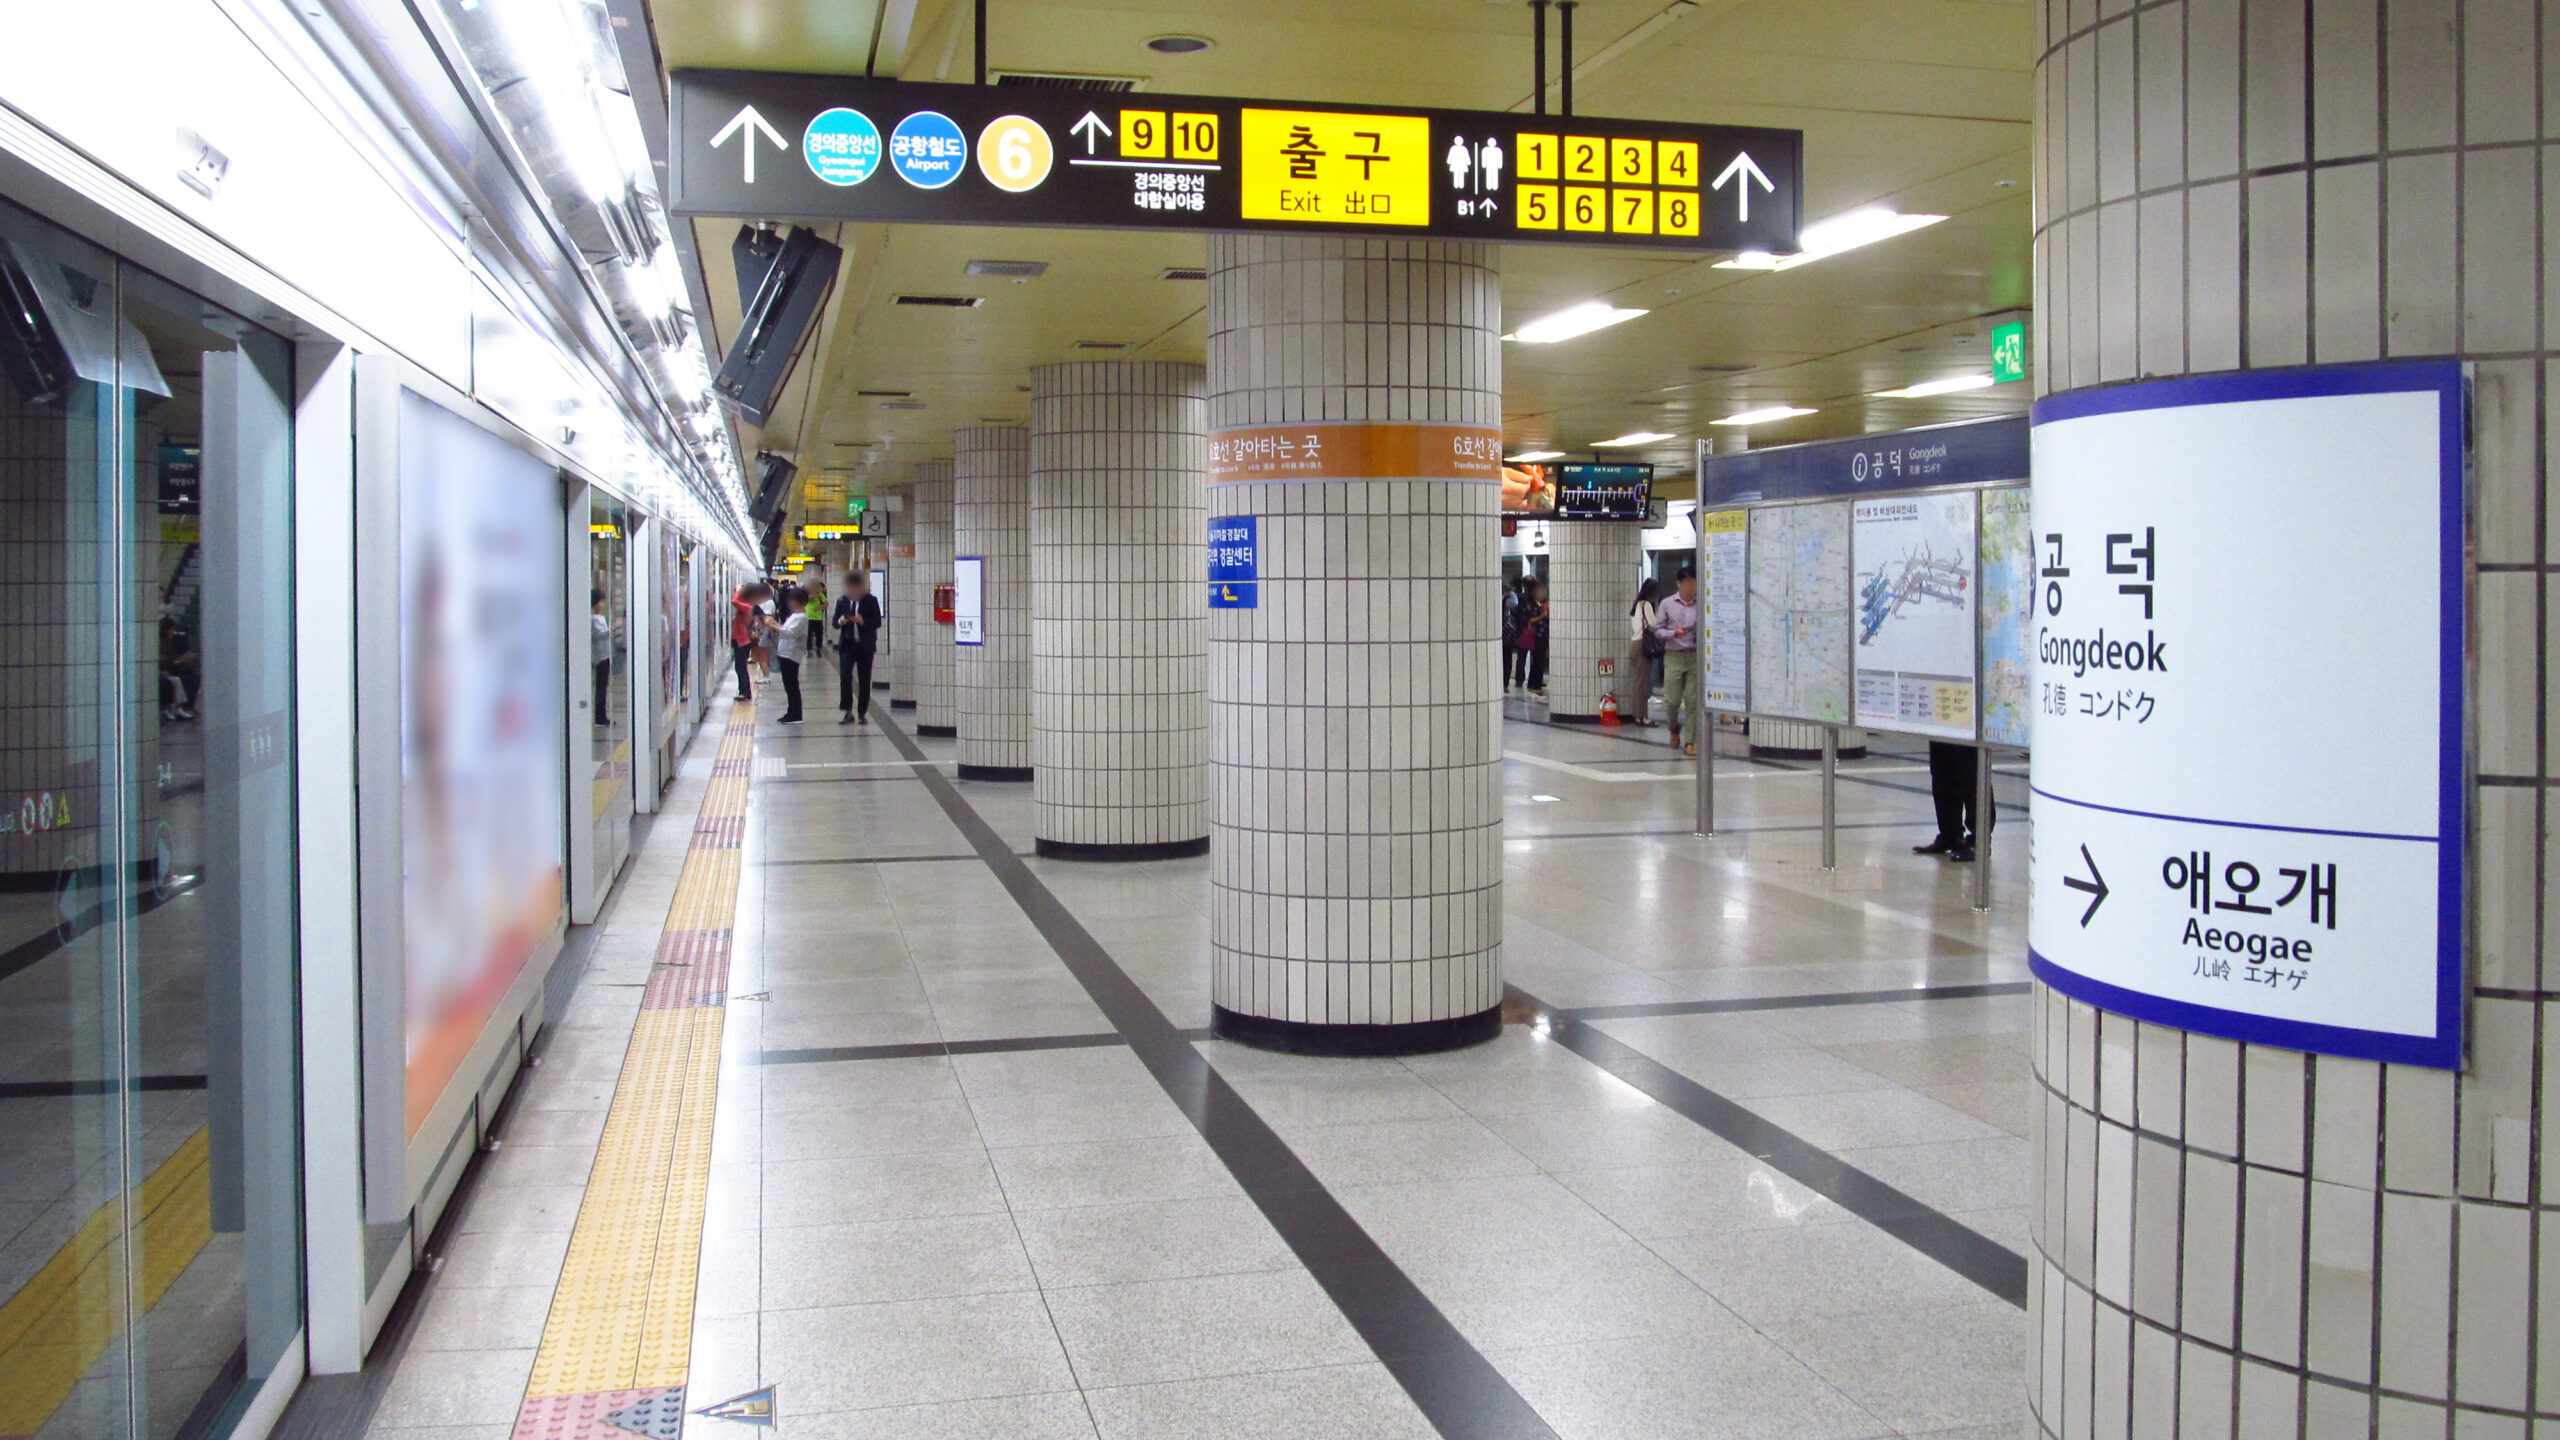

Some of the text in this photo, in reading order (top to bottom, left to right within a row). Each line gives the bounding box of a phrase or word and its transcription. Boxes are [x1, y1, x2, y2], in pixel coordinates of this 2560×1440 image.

[808, 134, 876, 155] 경의중앙선
[893, 136, 962, 158] 공항철도
[1132, 120, 1215, 152] 9 10
[818, 155, 866, 168] Gyeongui
[906, 157, 949, 172] Airport
[999, 129, 1031, 180] 6
[1531, 143, 1688, 178] 1 2 3 4
[1134, 172, 1205, 191] 경의중앙선
[1134, 191, 1205, 210] 대합실이용
[1280, 190, 1390, 214] Exit 出口
[1457, 200, 1474, 216] B1
[1528, 192, 1688, 228] 5 6 7 8
[1233, 435, 1296, 462] 갈아타는
[1302, 434, 1322, 459] 곳
[1453, 436, 1485, 460] 6호선
[1909, 445, 1947, 462] Gongdeok
[1872, 449, 1902, 479] 공덕
[1220, 547, 1253, 567] 경찰센터
[2042, 527, 2155, 619] 공덕
[2039, 627, 2168, 678] Gongdeok
[2080, 689, 2156, 724] コンドク
[2162, 850, 2337, 930] 애오개
[2182, 917, 2313, 965] Aeogae
[2243, 965, 2309, 990] エオゲ
